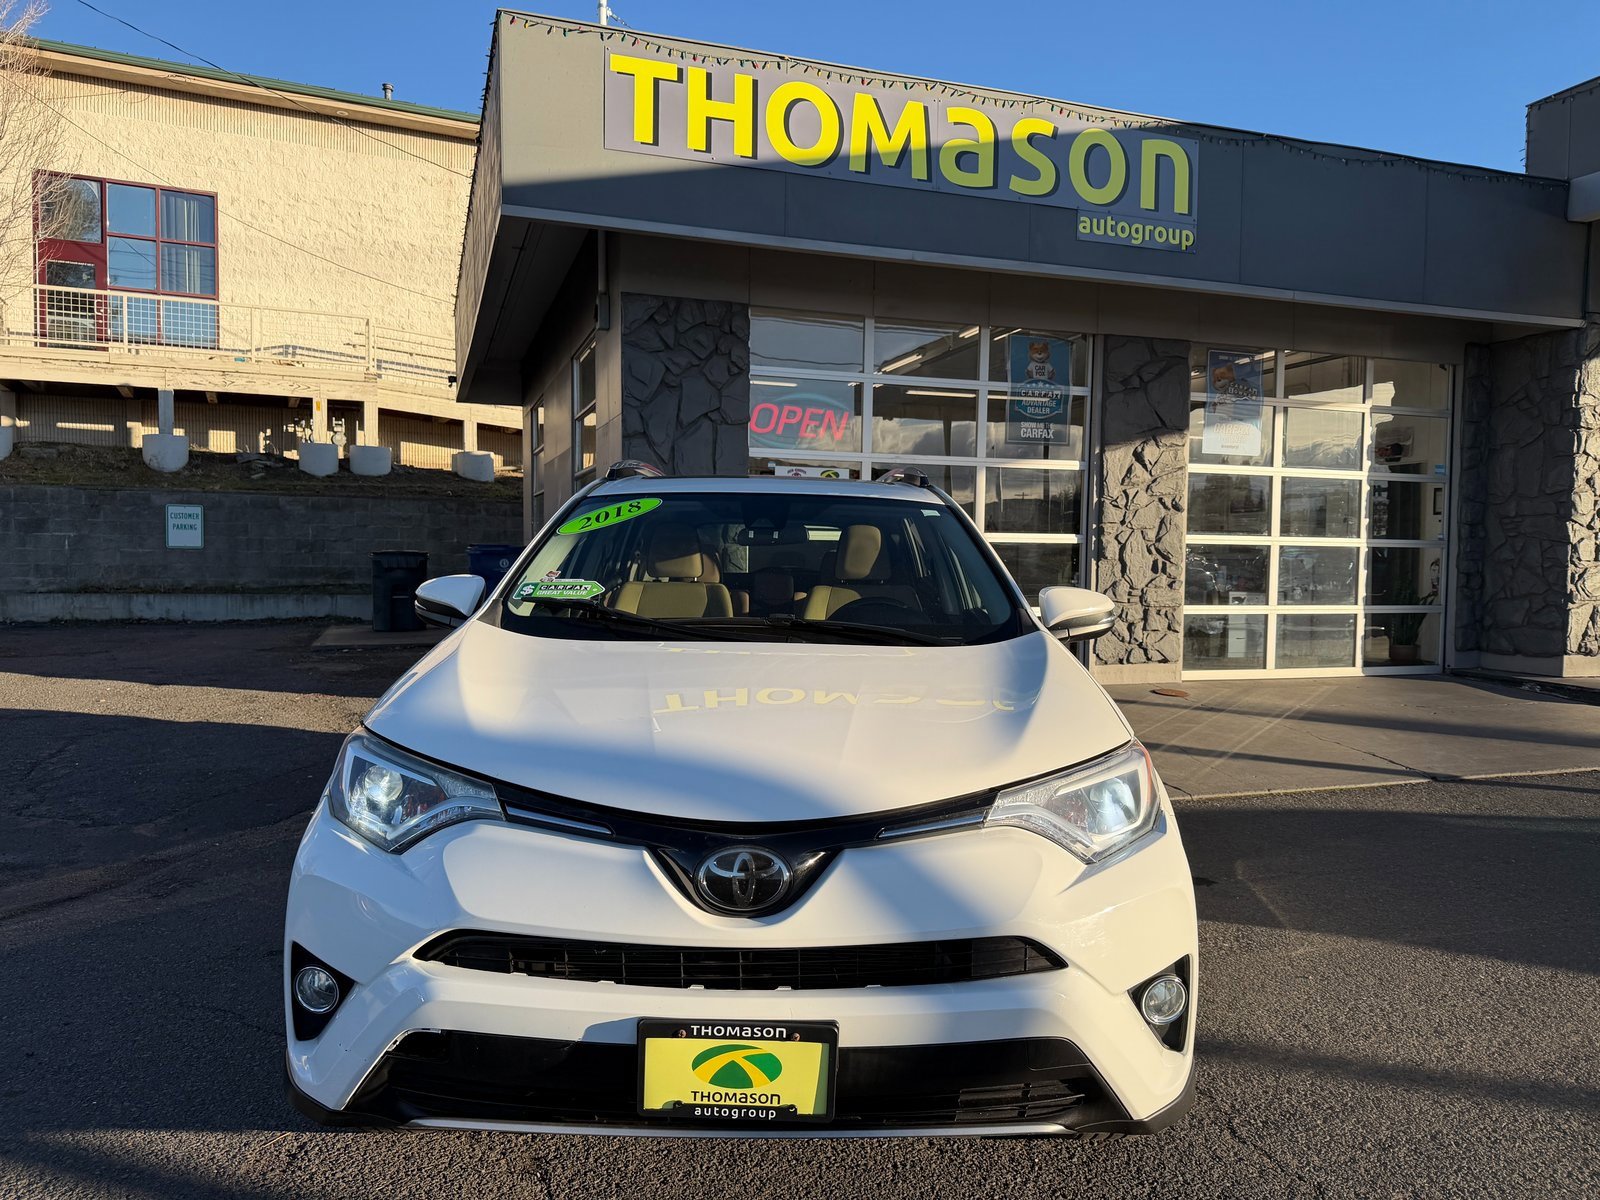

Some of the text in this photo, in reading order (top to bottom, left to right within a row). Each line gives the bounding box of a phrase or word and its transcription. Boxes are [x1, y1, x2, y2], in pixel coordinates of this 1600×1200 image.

[1078, 213, 1195, 250] autogroup
[1021, 390, 1061, 399] CARFAX
[1021, 400, 1057, 408] ADVANTAGE
[749, 403, 849, 441] OPEN
[1021, 428, 1054, 438] CARFAX
[170, 512, 200, 520] CUSTOMER
[578, 501, 642, 530] 2018
[694, 1106, 777, 1120] autogroup
